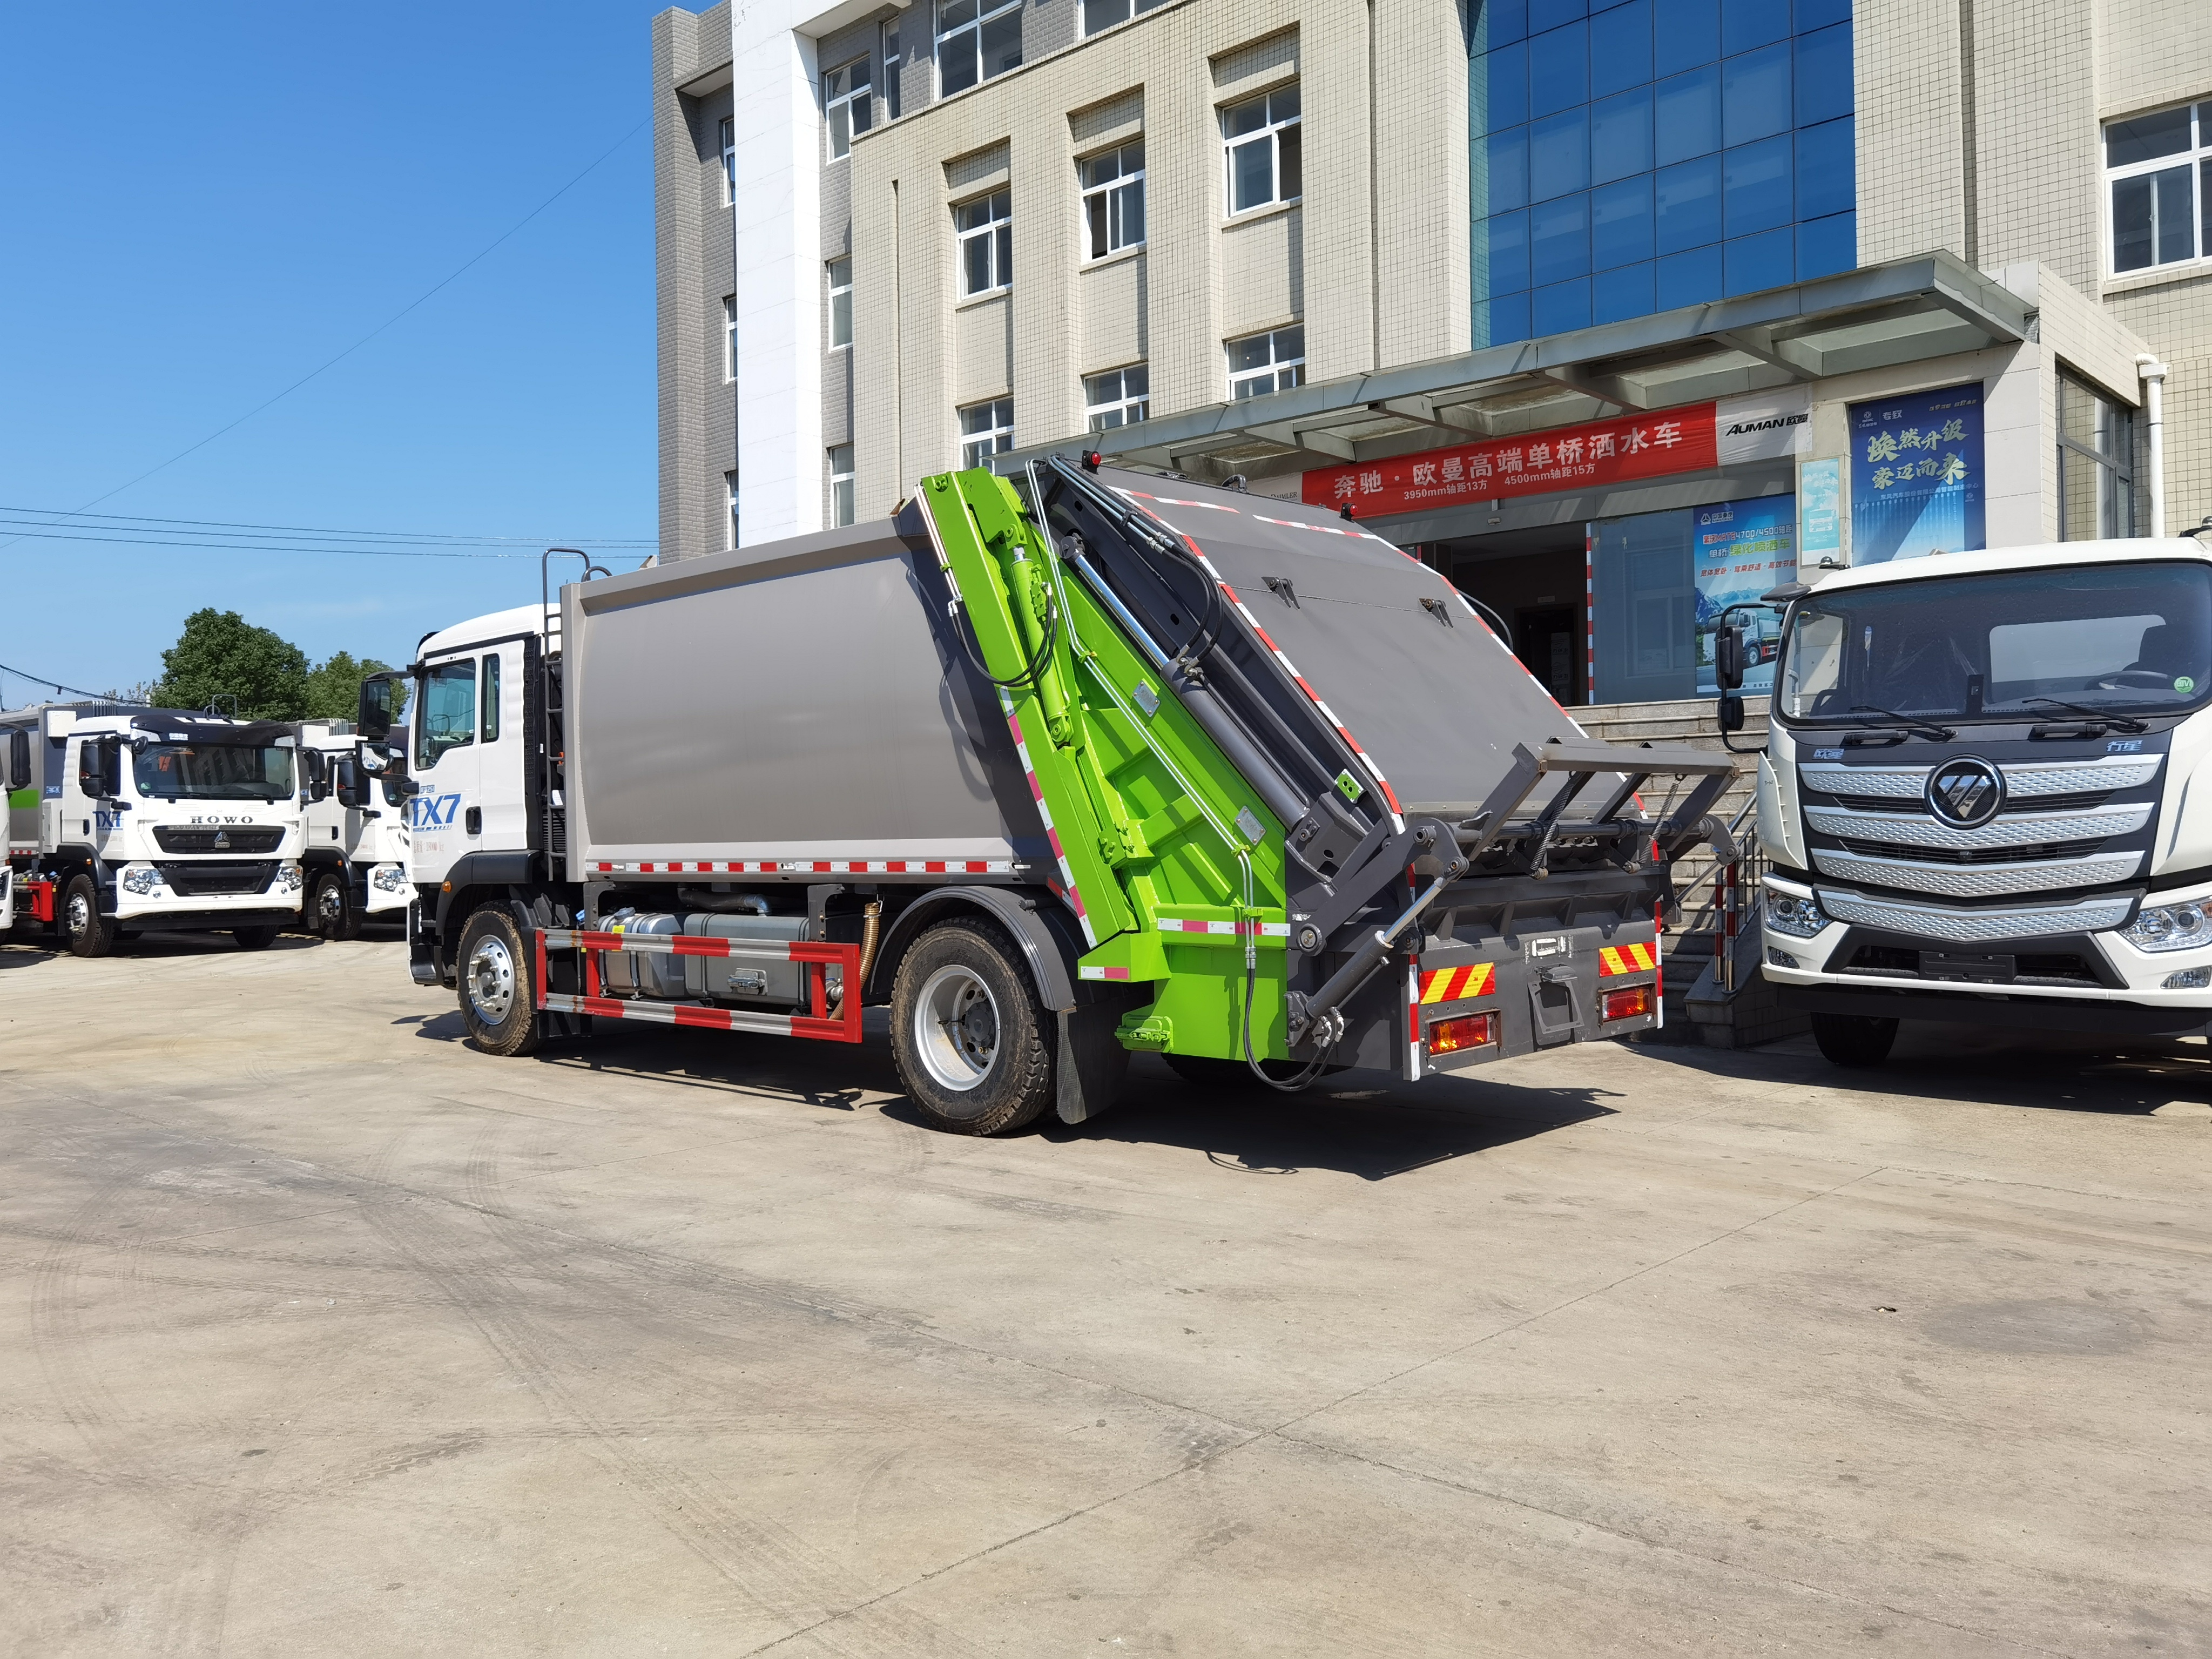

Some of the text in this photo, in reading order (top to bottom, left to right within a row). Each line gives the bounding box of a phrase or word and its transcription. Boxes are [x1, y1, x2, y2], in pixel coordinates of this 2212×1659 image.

[1726, 413, 1809, 436] AUMAN 欧曼
[1867, 418, 1970, 463] 焕然升级
[1334, 421, 1683, 499] 奔驰·欧曼高端单桥洒水车
[1871, 451, 1971, 490] 豪迈而来
[1403, 462, 1596, 500] 3950mm轴距13方 4500mm轴距15方
[2107, 740, 2143, 752] 行星
[410, 793, 461, 826] TX7
